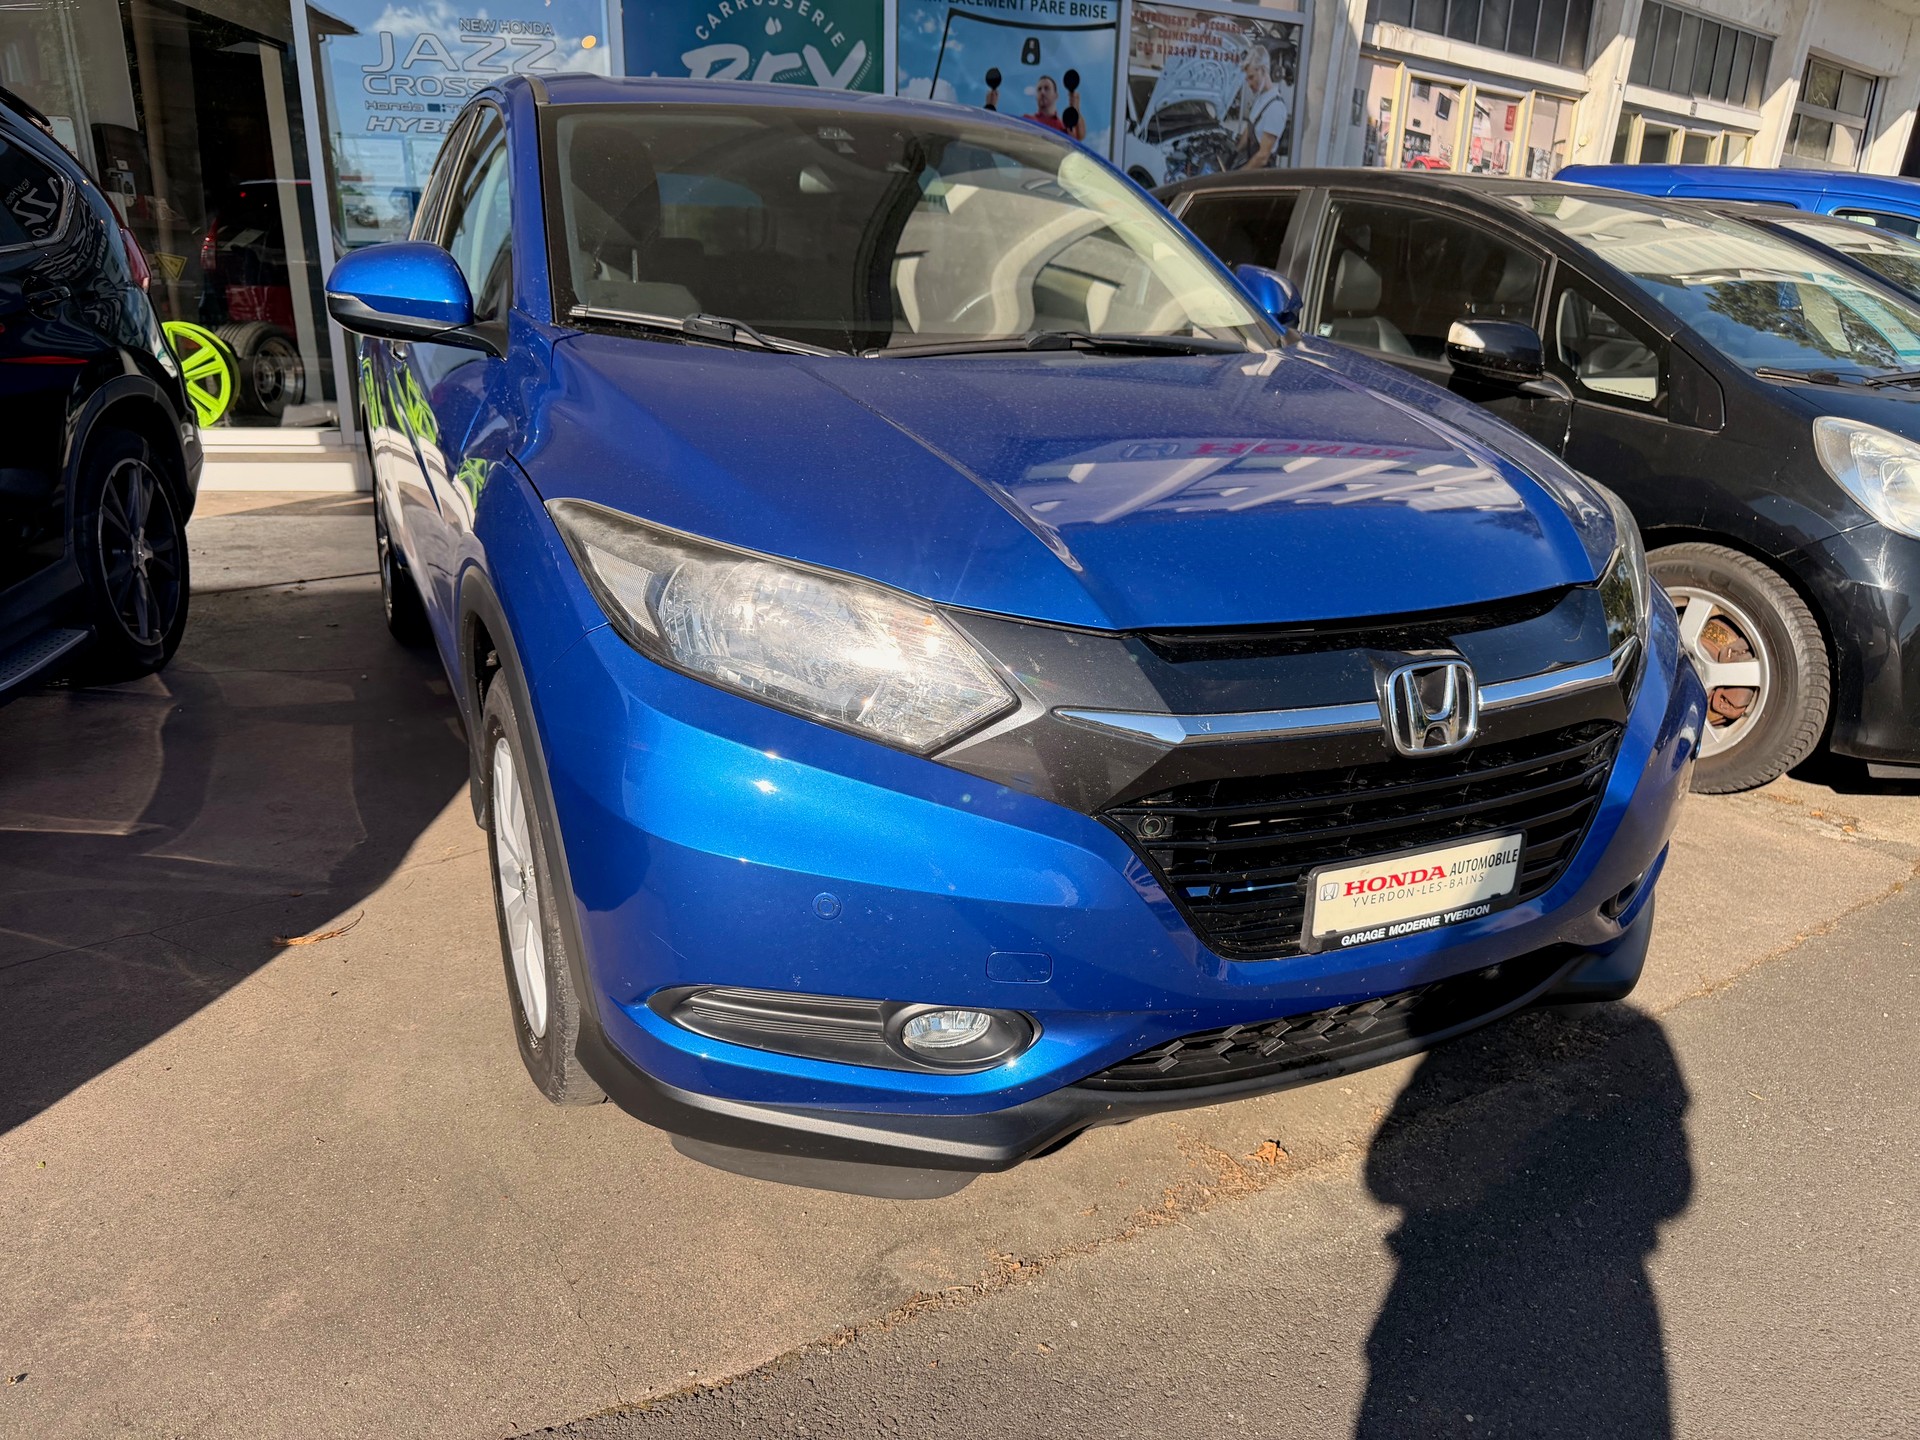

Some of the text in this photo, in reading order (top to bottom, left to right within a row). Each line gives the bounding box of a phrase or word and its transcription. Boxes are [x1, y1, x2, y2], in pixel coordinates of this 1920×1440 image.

[459, 18, 554, 36] NEW HONDA
[1030, 0, 1066, 15] PARE
[1070, 2, 1108, 19] BRISE
[361, 31, 557, 75] JAZZ
[364, 100, 425, 112] Honda
[1343, 849, 1518, 897] HONDA AUTOMOBILE
[1352, 871, 1485, 908] YVERDON-LES-BAINS
[1341, 904, 1490, 946] GARAGE MODERNE YVERDON
